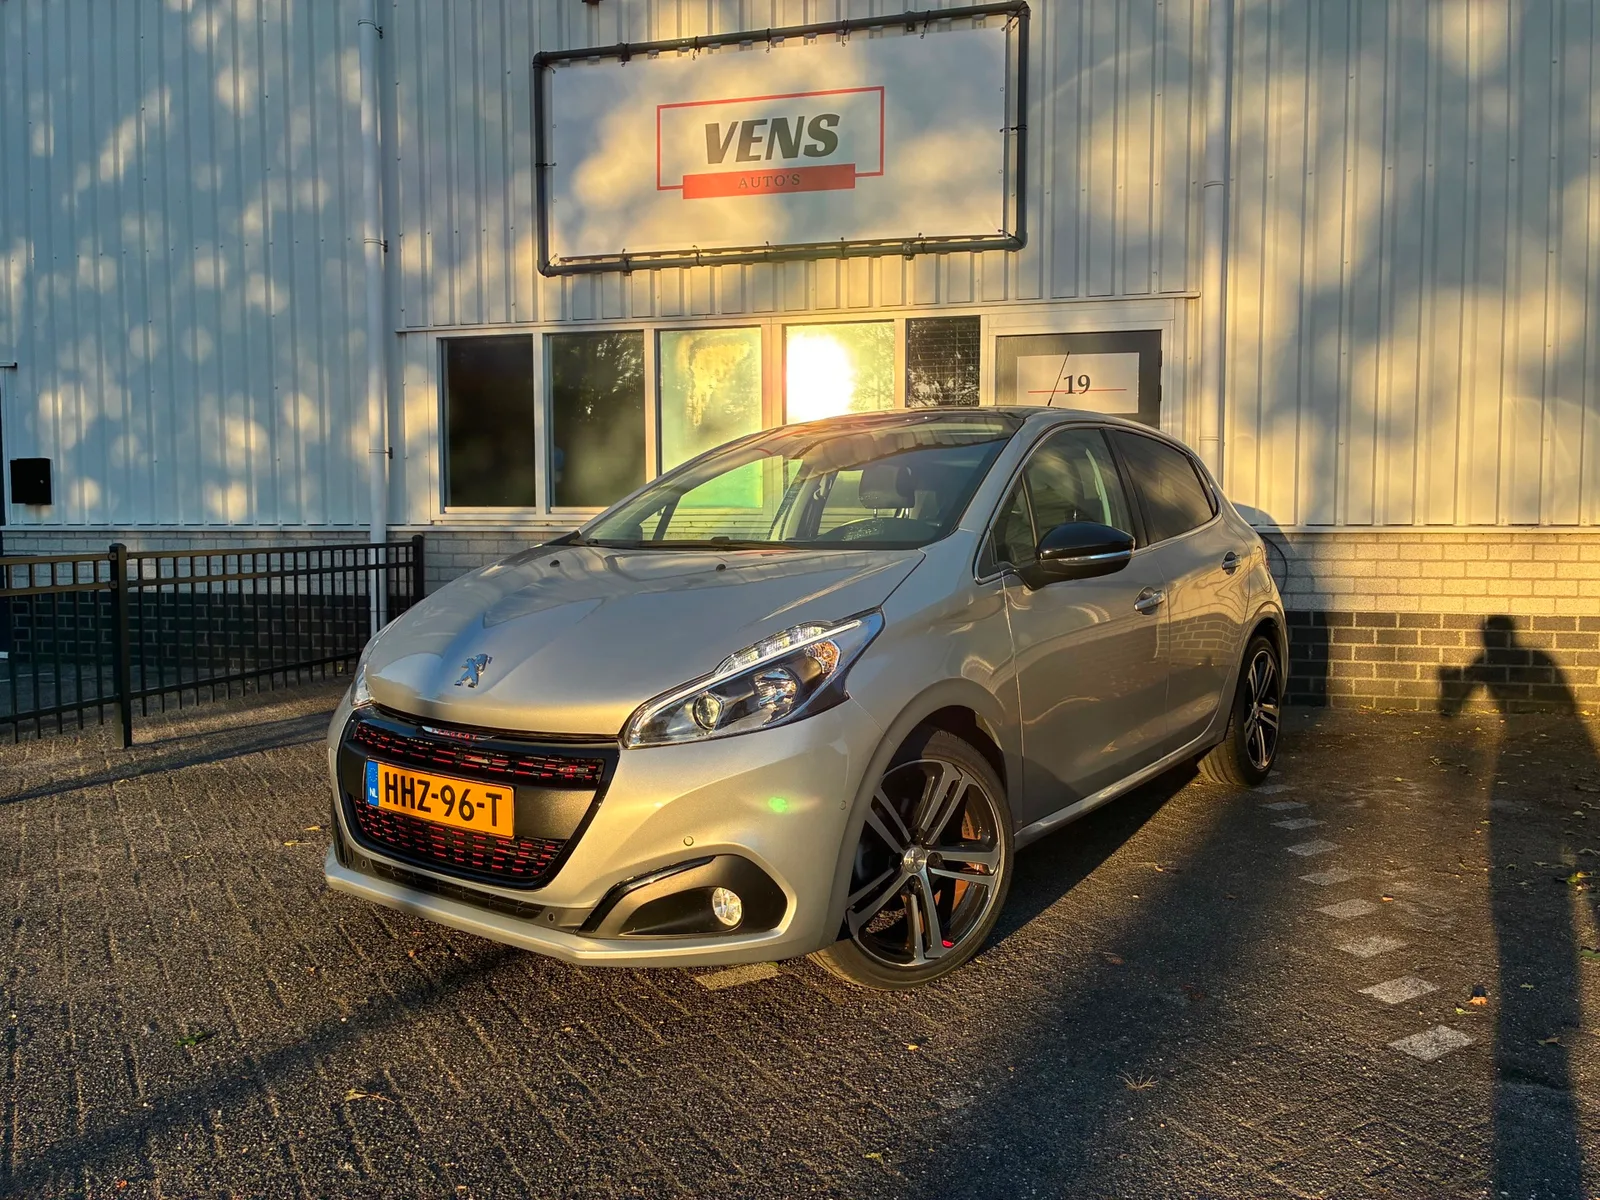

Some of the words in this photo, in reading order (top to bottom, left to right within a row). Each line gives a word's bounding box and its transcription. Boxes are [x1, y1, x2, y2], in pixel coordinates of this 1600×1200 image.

[705, 113, 840, 164] VENS
[738, 174, 801, 189] AUTO'S
[1064, 374, 1091, 395] 19
[369, 786, 378, 799] NL
[384, 771, 503, 827] HHZ-96-T
